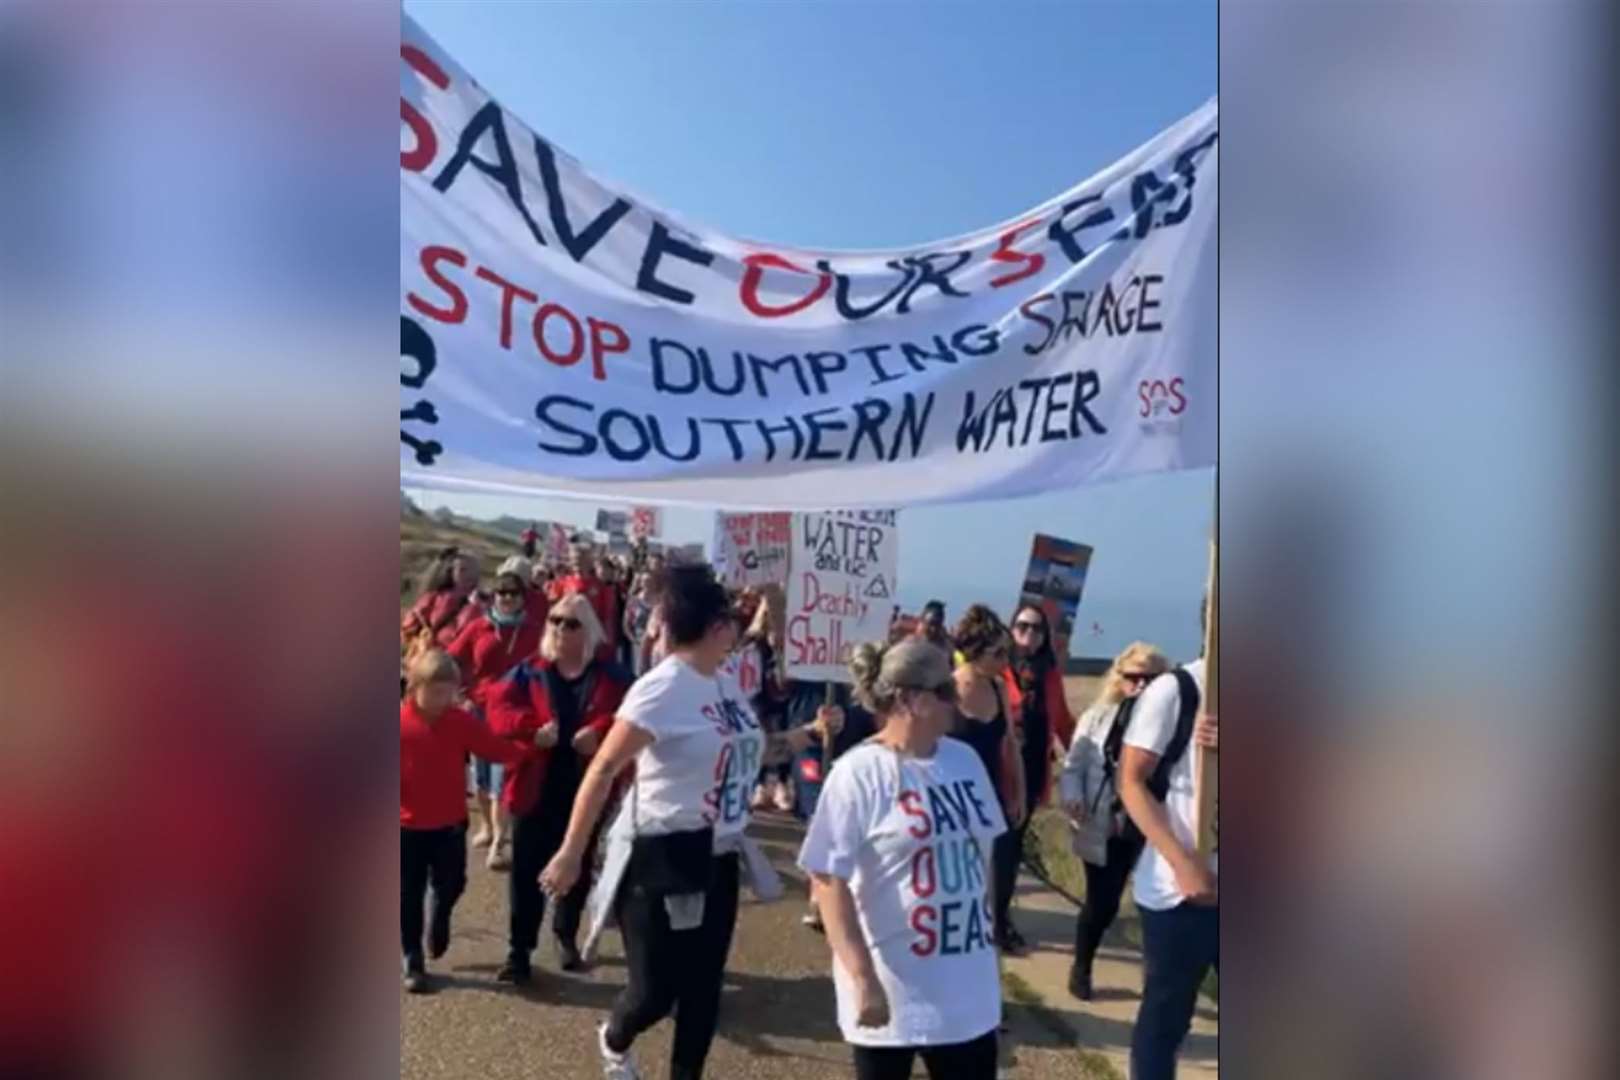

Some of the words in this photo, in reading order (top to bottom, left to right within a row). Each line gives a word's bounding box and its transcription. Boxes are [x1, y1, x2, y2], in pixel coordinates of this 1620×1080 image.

[400, 44, 715, 304] SAVE
[740, 251, 972, 319] OUR
[407, 244, 631, 380] STOP
[650, 323, 1000, 398] DUMPING
[535, 391, 935, 463] SOUTHERN
[956, 369, 1107, 453] WATER
[803, 513, 883, 562] WATER
[899, 779, 993, 840] SAVE
[912, 837, 985, 898] OUR
